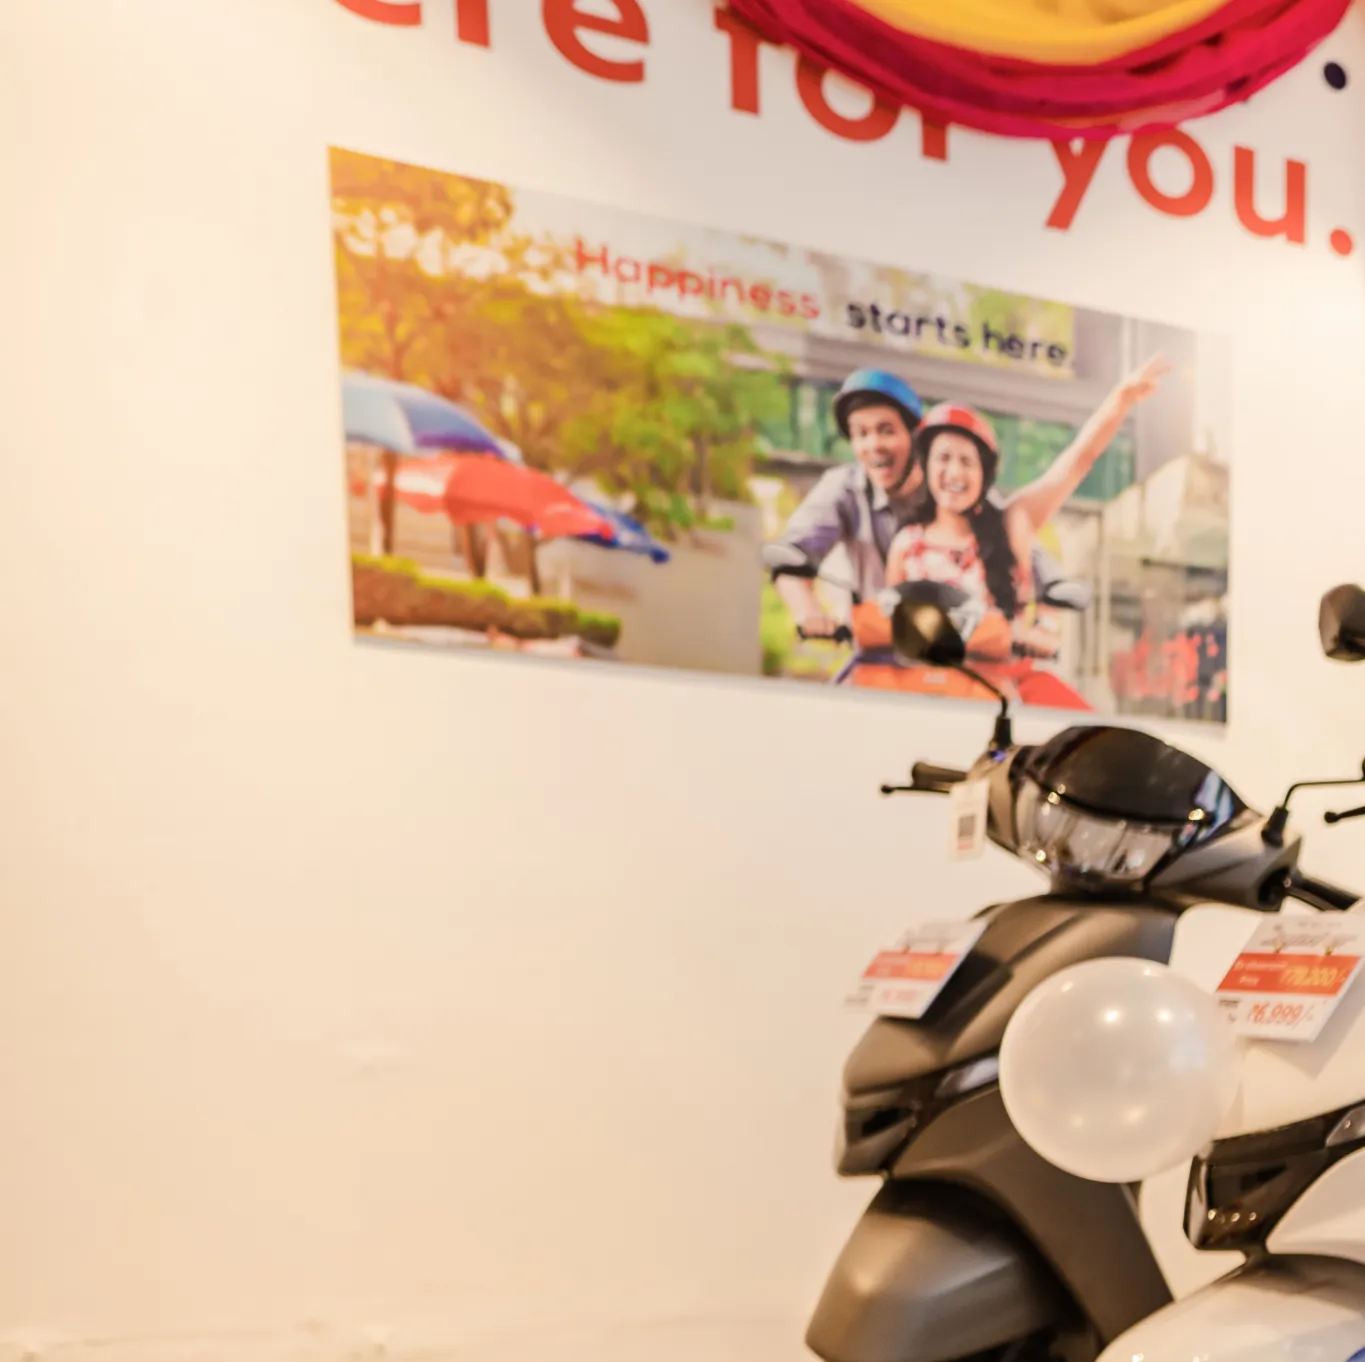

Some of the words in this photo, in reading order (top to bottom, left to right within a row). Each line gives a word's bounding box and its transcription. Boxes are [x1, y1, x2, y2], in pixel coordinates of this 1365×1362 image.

[1045, 122, 1353, 256] you.
[574, 237, 822, 320] Happiness
[846, 301, 970, 350] starts
